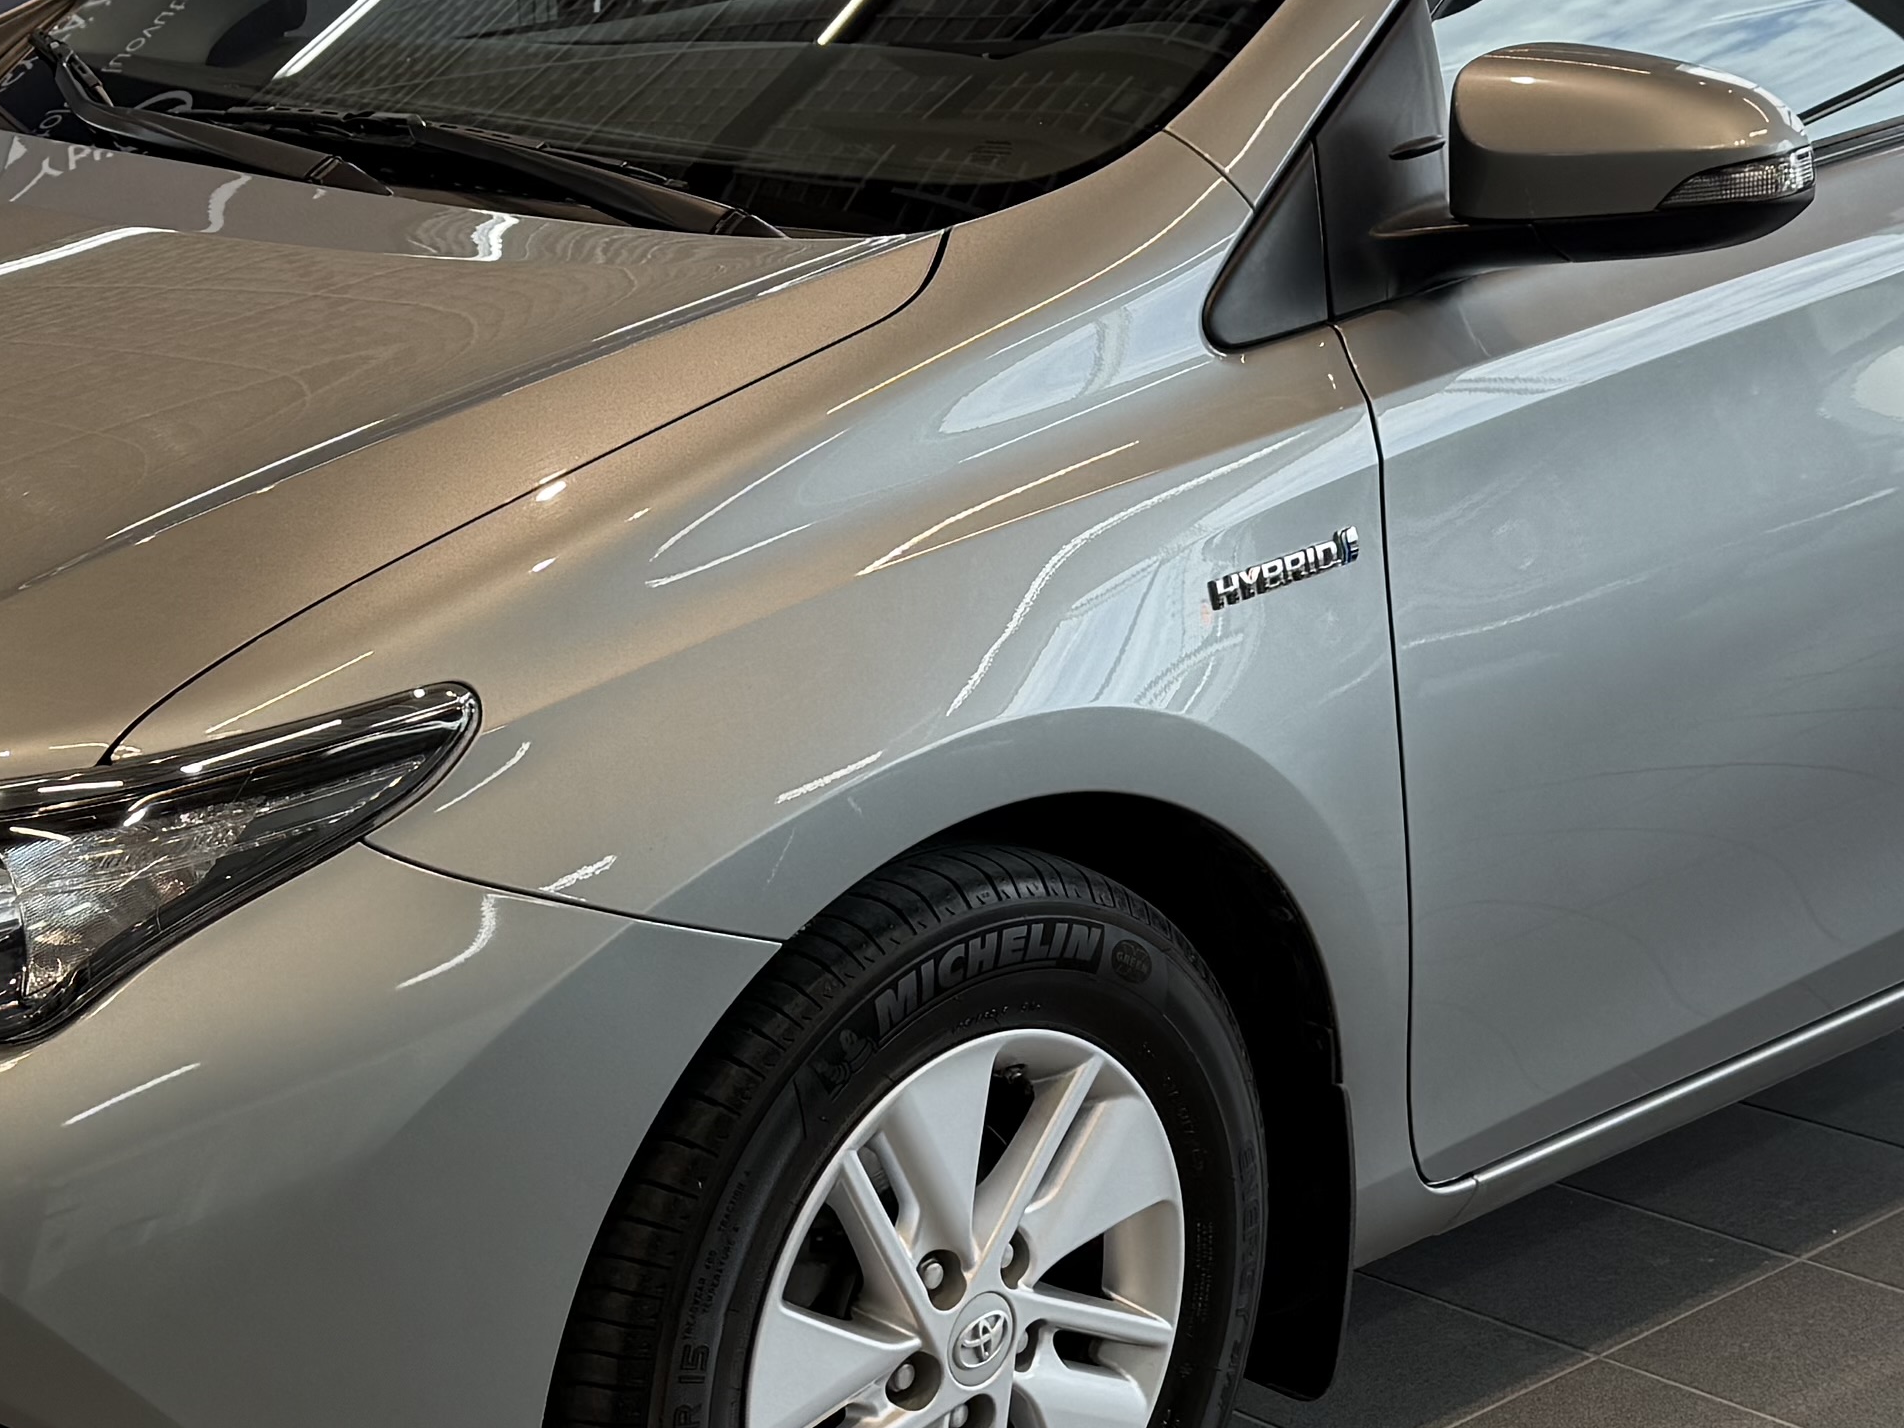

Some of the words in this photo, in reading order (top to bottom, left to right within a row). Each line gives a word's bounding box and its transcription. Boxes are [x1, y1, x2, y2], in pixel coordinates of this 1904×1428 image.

[1207, 539, 1343, 611] HYBRID
[874, 922, 1103, 1032] MICHELIN
[678, 1343, 711, 1385] 15
